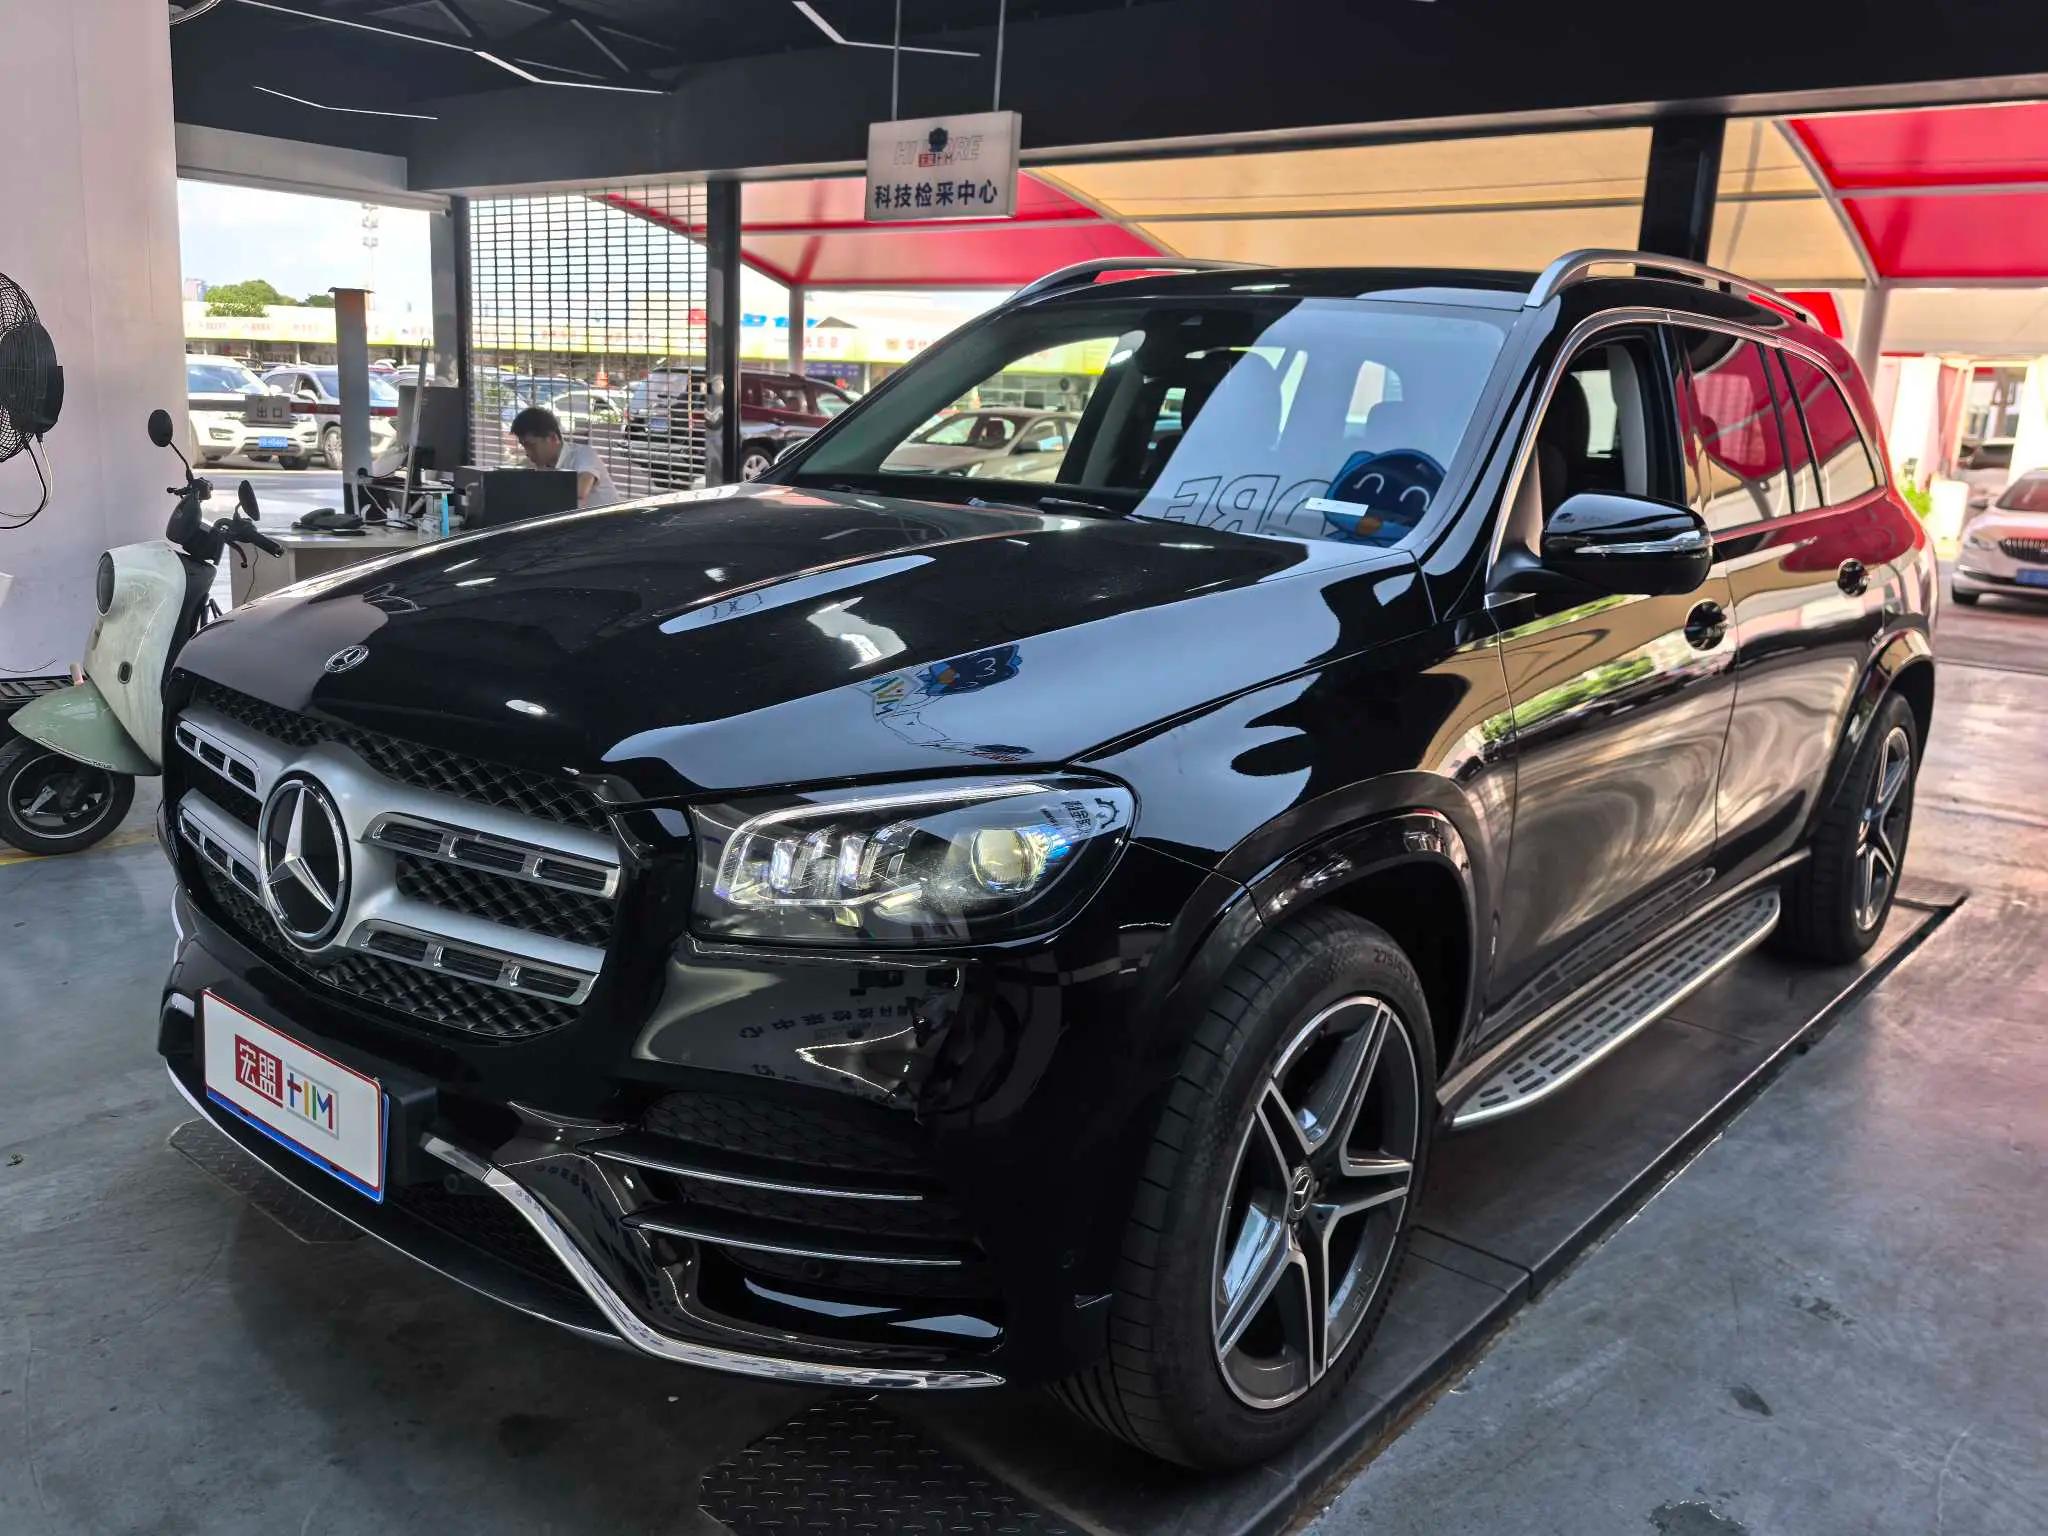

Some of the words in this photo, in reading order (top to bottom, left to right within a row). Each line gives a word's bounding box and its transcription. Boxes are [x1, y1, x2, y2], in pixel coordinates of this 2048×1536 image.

[874, 179, 998, 210] 科技检采中心
[256, 401, 283, 417] 出口
[239, 1042, 276, 1097] 宏盟
